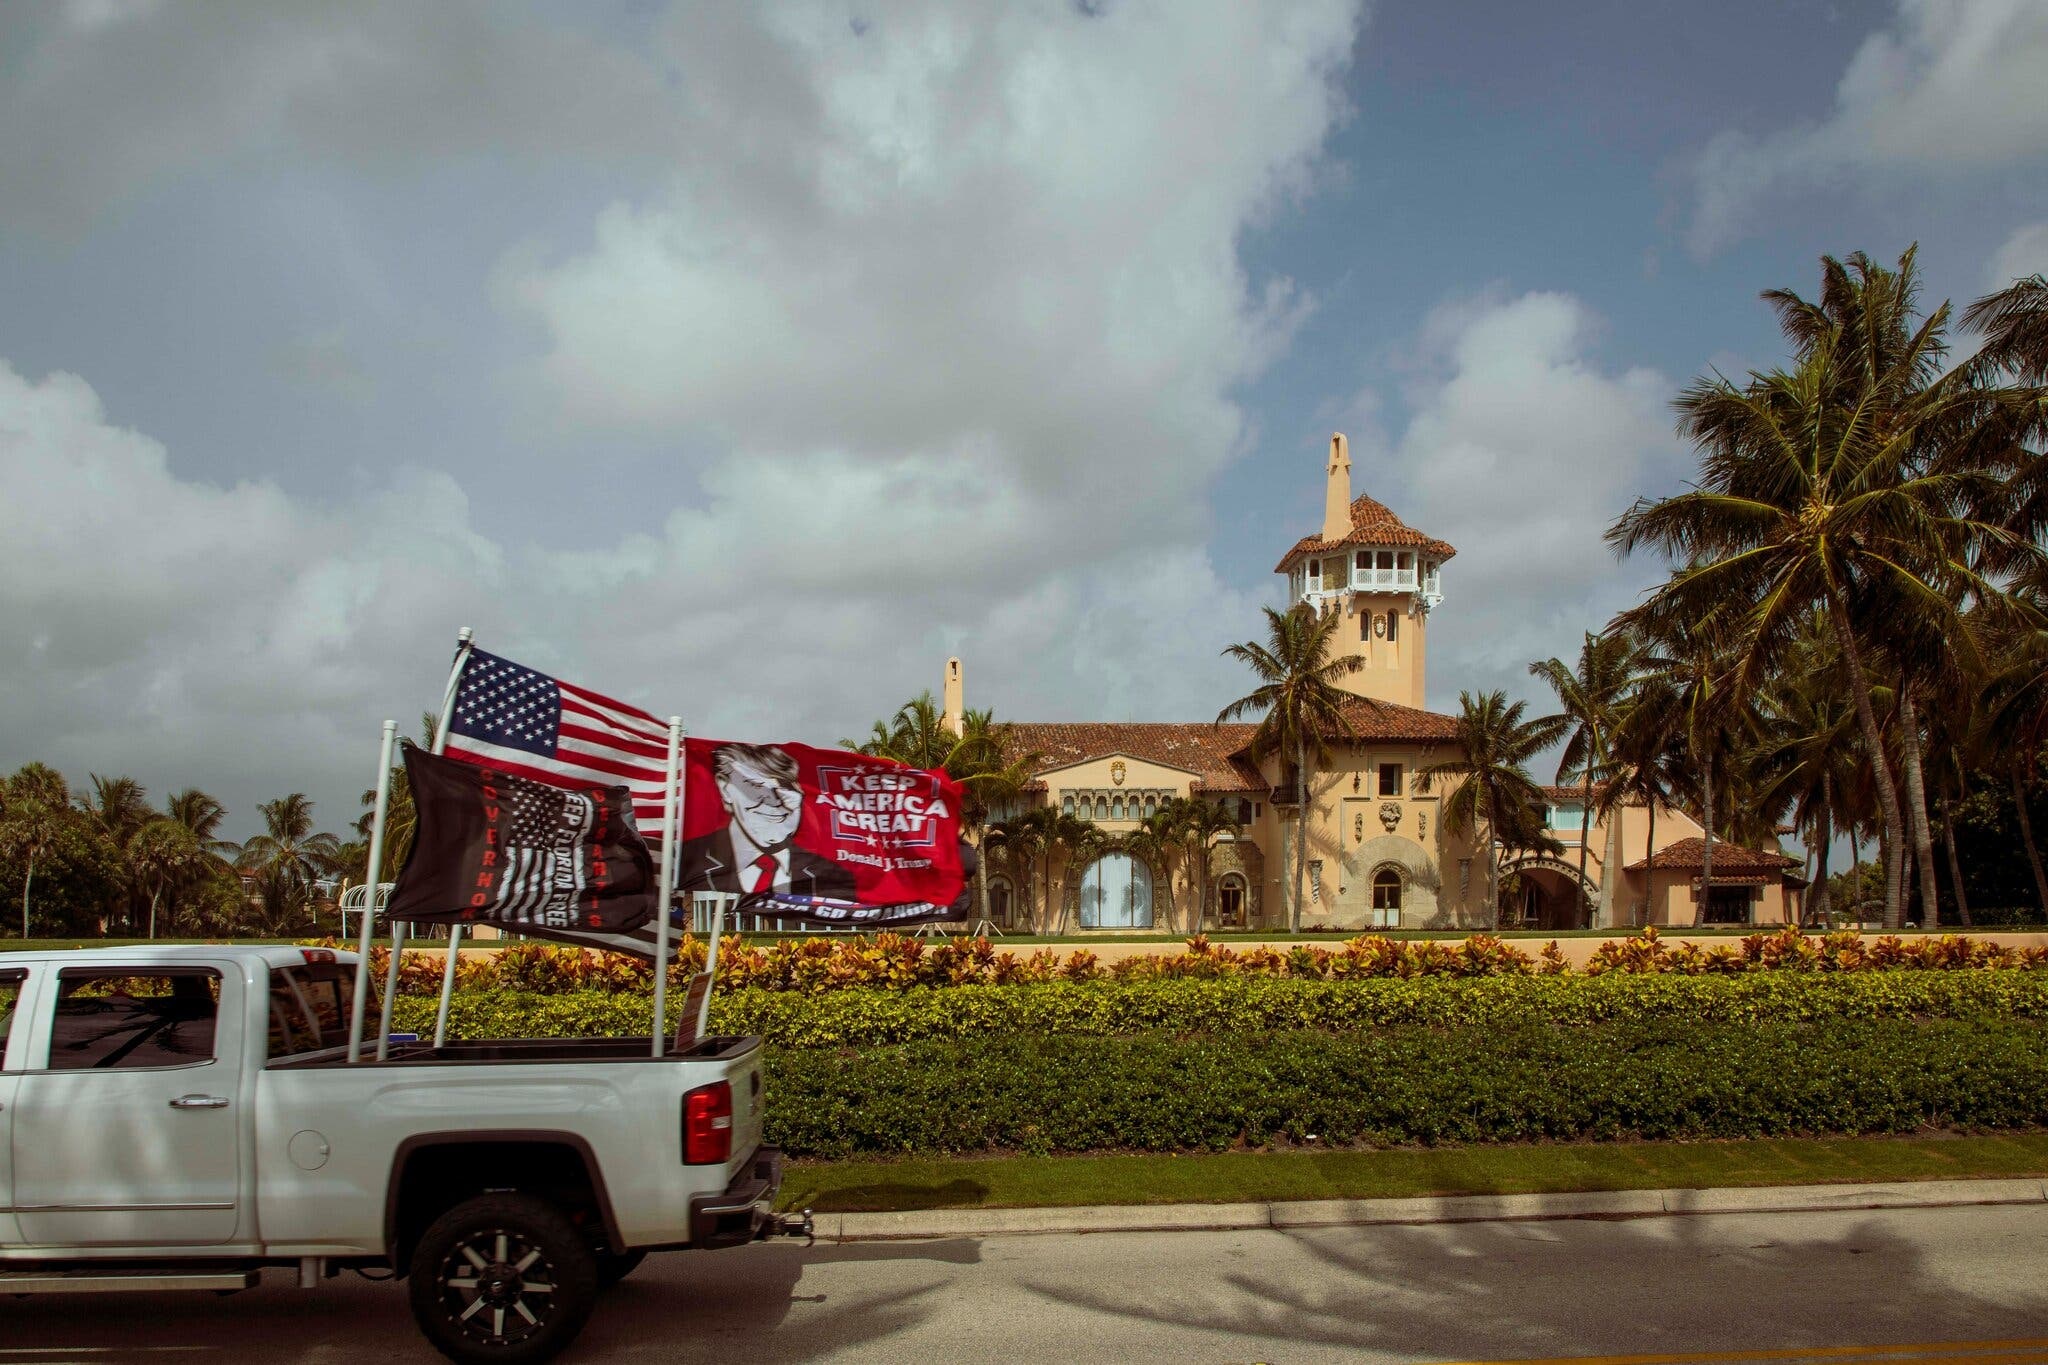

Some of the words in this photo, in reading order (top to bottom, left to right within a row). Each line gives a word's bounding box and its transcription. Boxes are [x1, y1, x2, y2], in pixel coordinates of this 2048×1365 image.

[840, 774, 917, 791] KEEP
[816, 793, 950, 819] AMERICA
[838, 811, 927, 832] GREAT
[553, 828, 578, 889] FLORIDA
[836, 849, 883, 868] Donald
[546, 893, 570, 927] FREE
